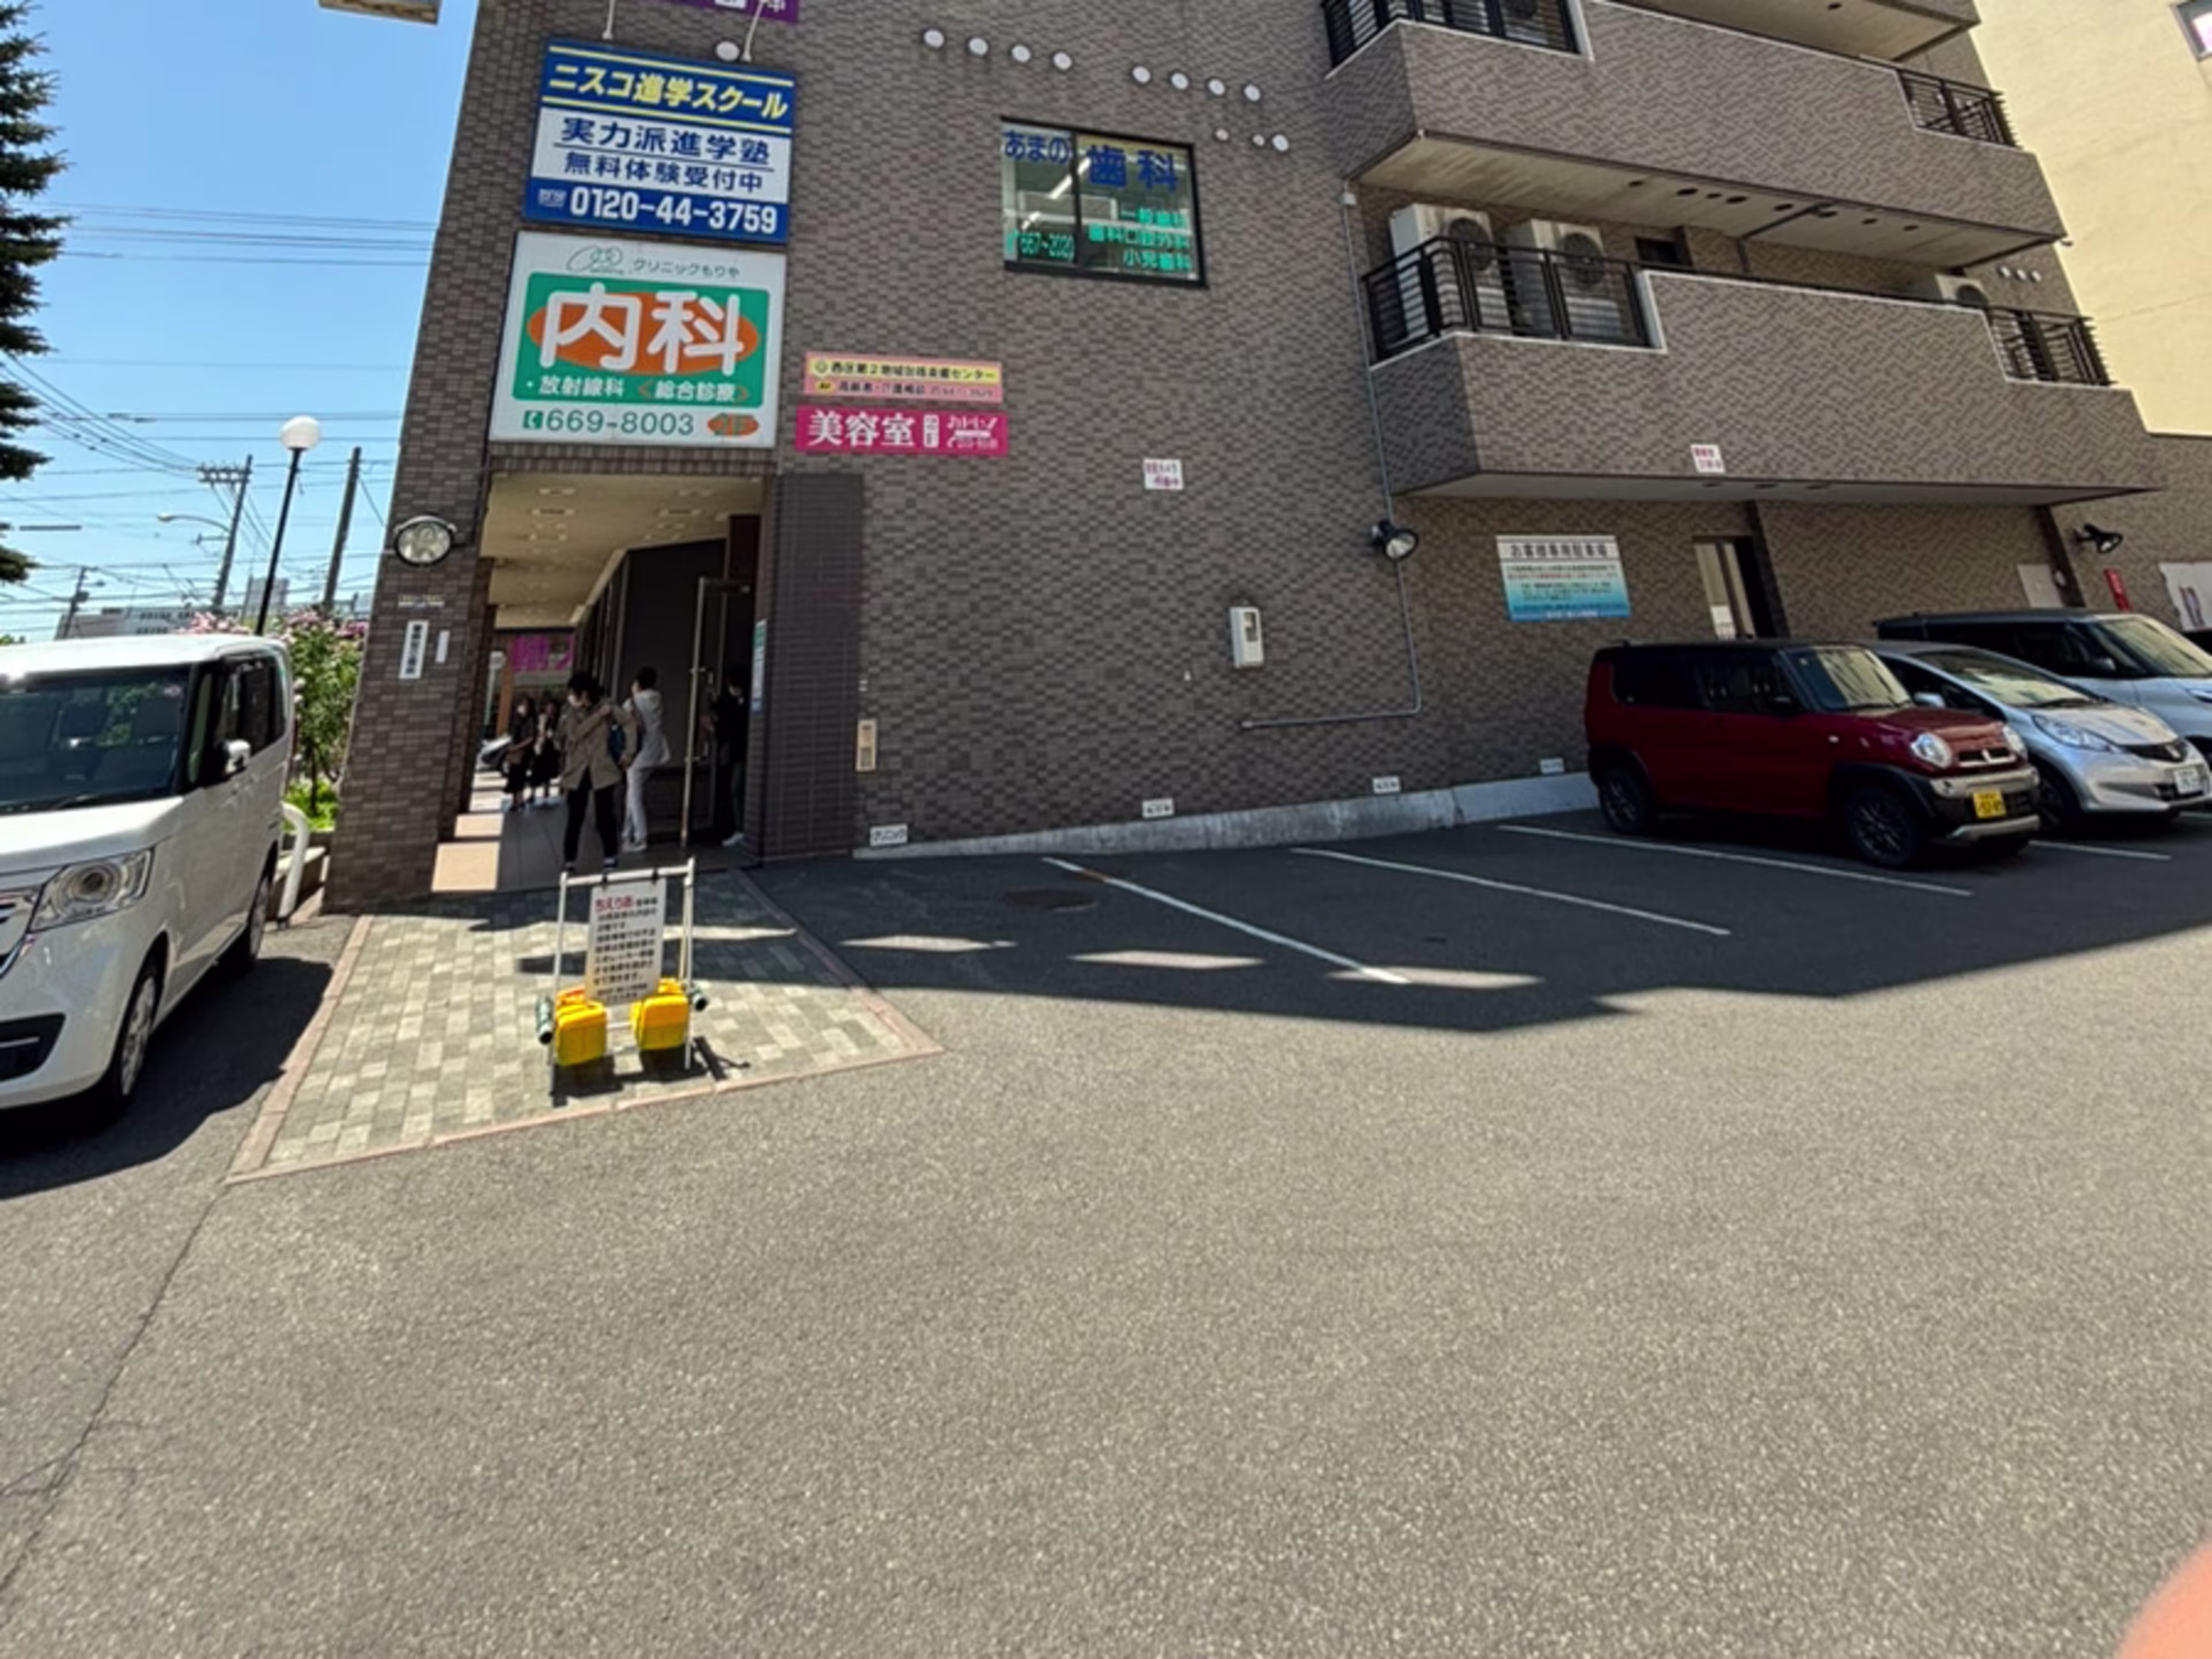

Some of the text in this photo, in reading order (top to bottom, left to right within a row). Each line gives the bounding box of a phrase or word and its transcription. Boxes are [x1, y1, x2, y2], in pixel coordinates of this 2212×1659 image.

[550, 63, 788, 120] ニスコ進学スクール
[561, 117, 770, 165] 実力派進学塾
[1004, 131, 1177, 191] あまの 歯科
[563, 152, 763, 194] 無料体験受付中
[570, 187, 777, 234] 0120-44-3759
[633, 259, 740, 278] クリニックもりや
[538, 282, 745, 376] 内科
[546, 410, 694, 435] 669-8003
[808, 410, 916, 448] 美容室
